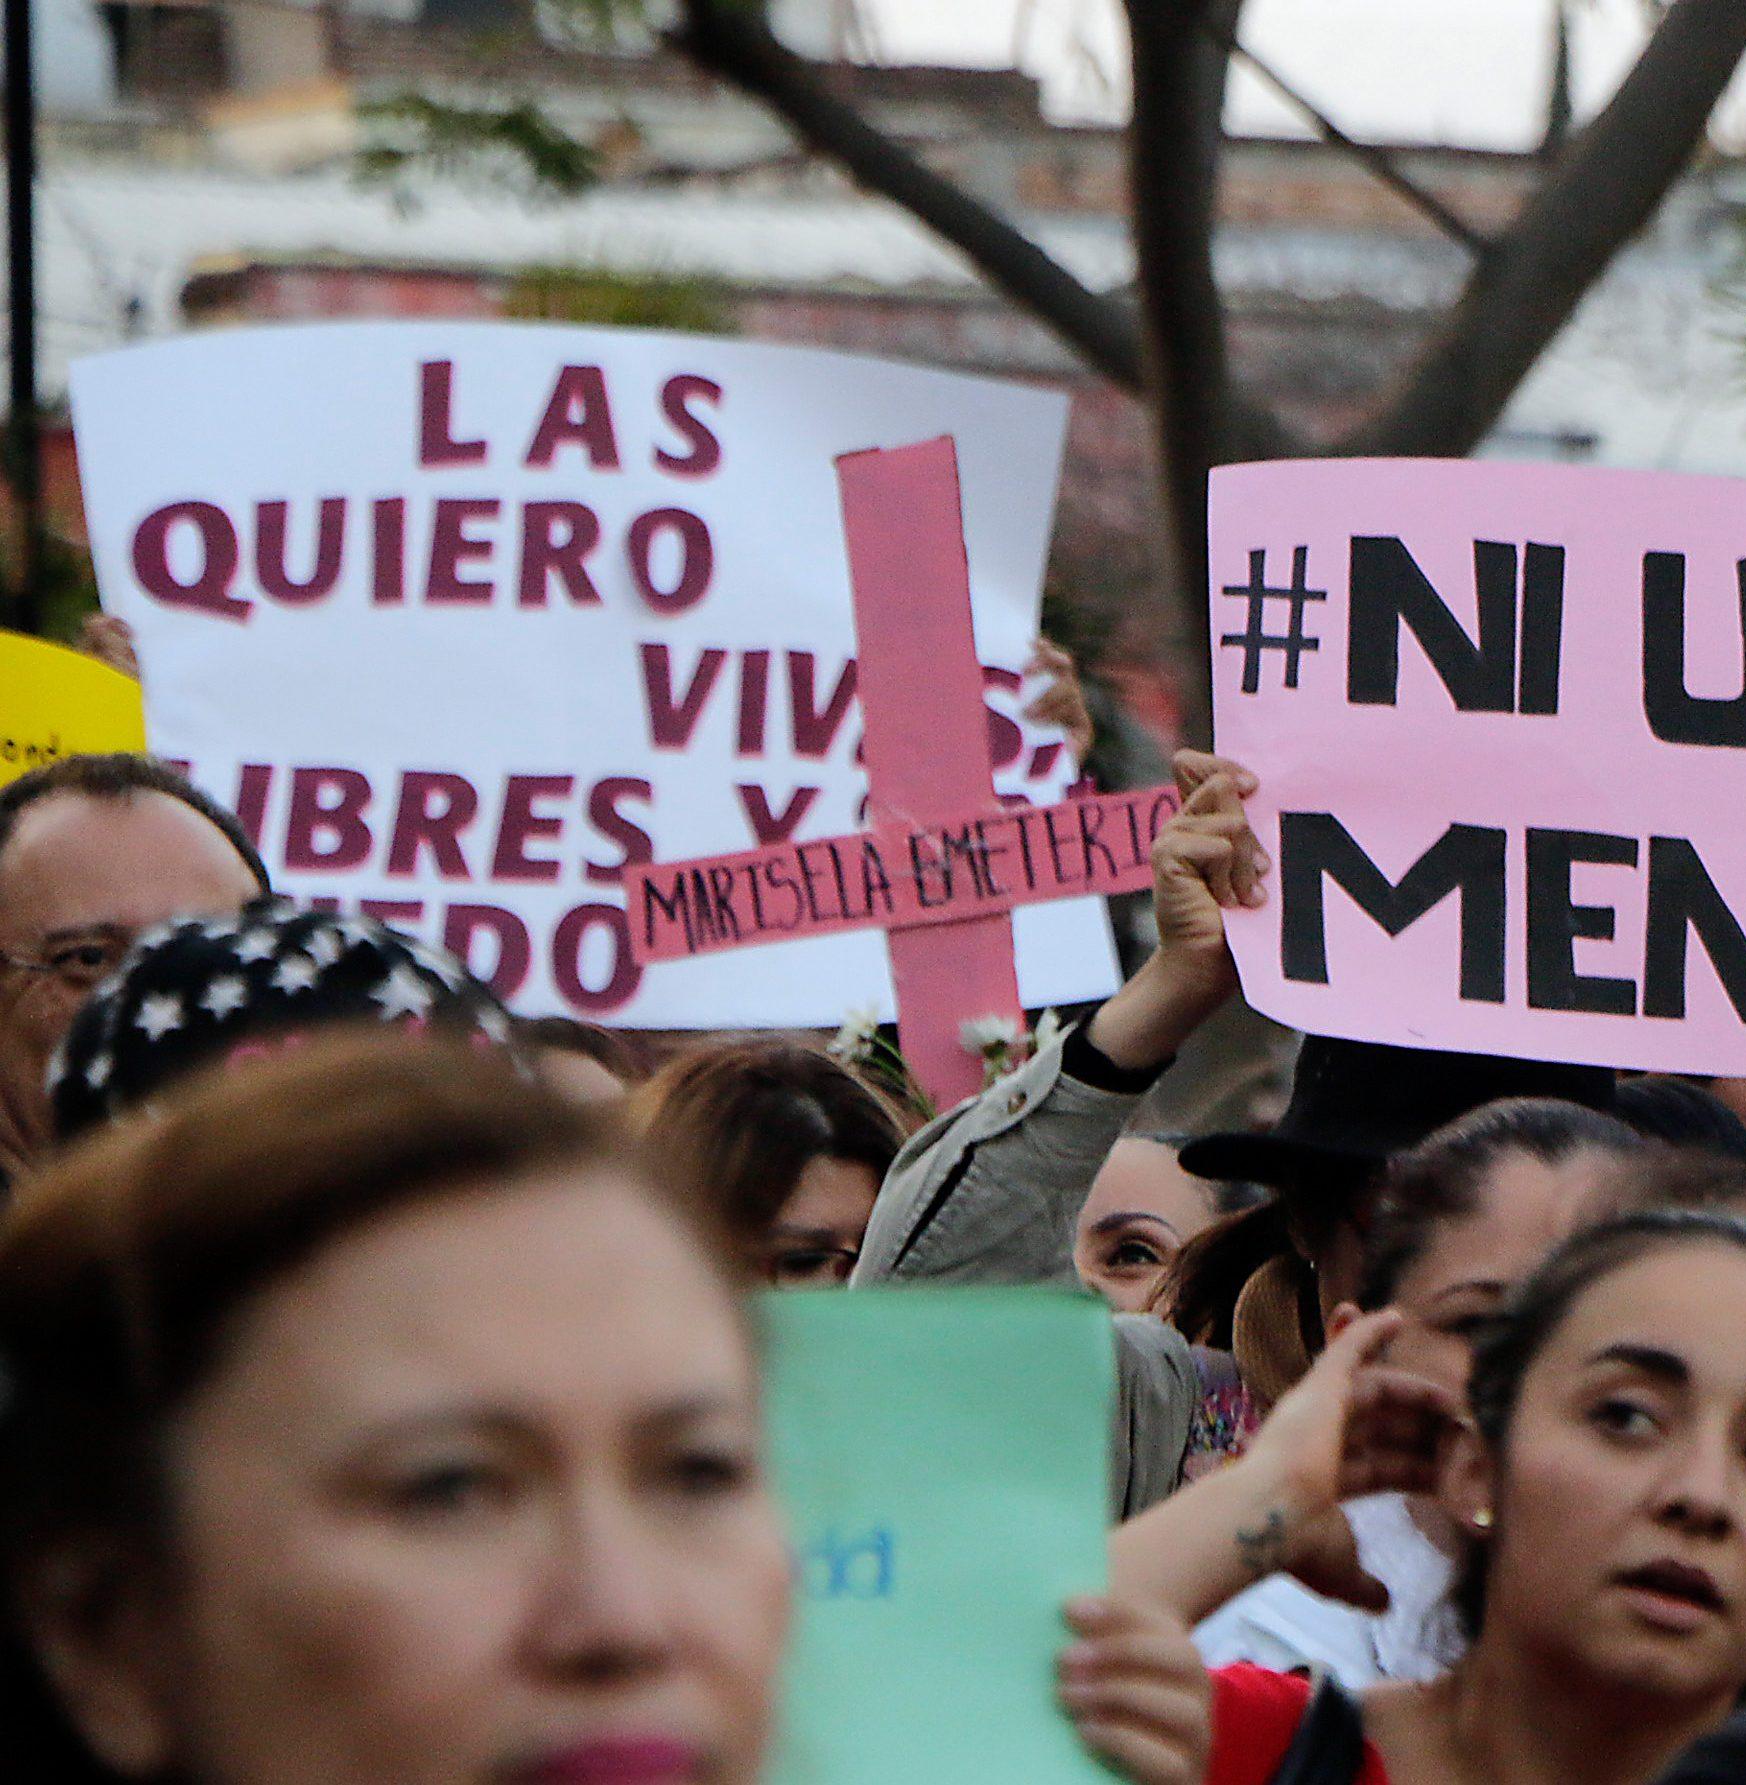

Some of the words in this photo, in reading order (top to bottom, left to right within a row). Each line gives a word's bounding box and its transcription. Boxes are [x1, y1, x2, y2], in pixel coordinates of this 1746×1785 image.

[418, 359, 724, 478] LAS
[130, 496, 714, 623] QUIERO
[1220, 535, 1566, 716] #NI
[165, 757, 656, 884] IBRES
